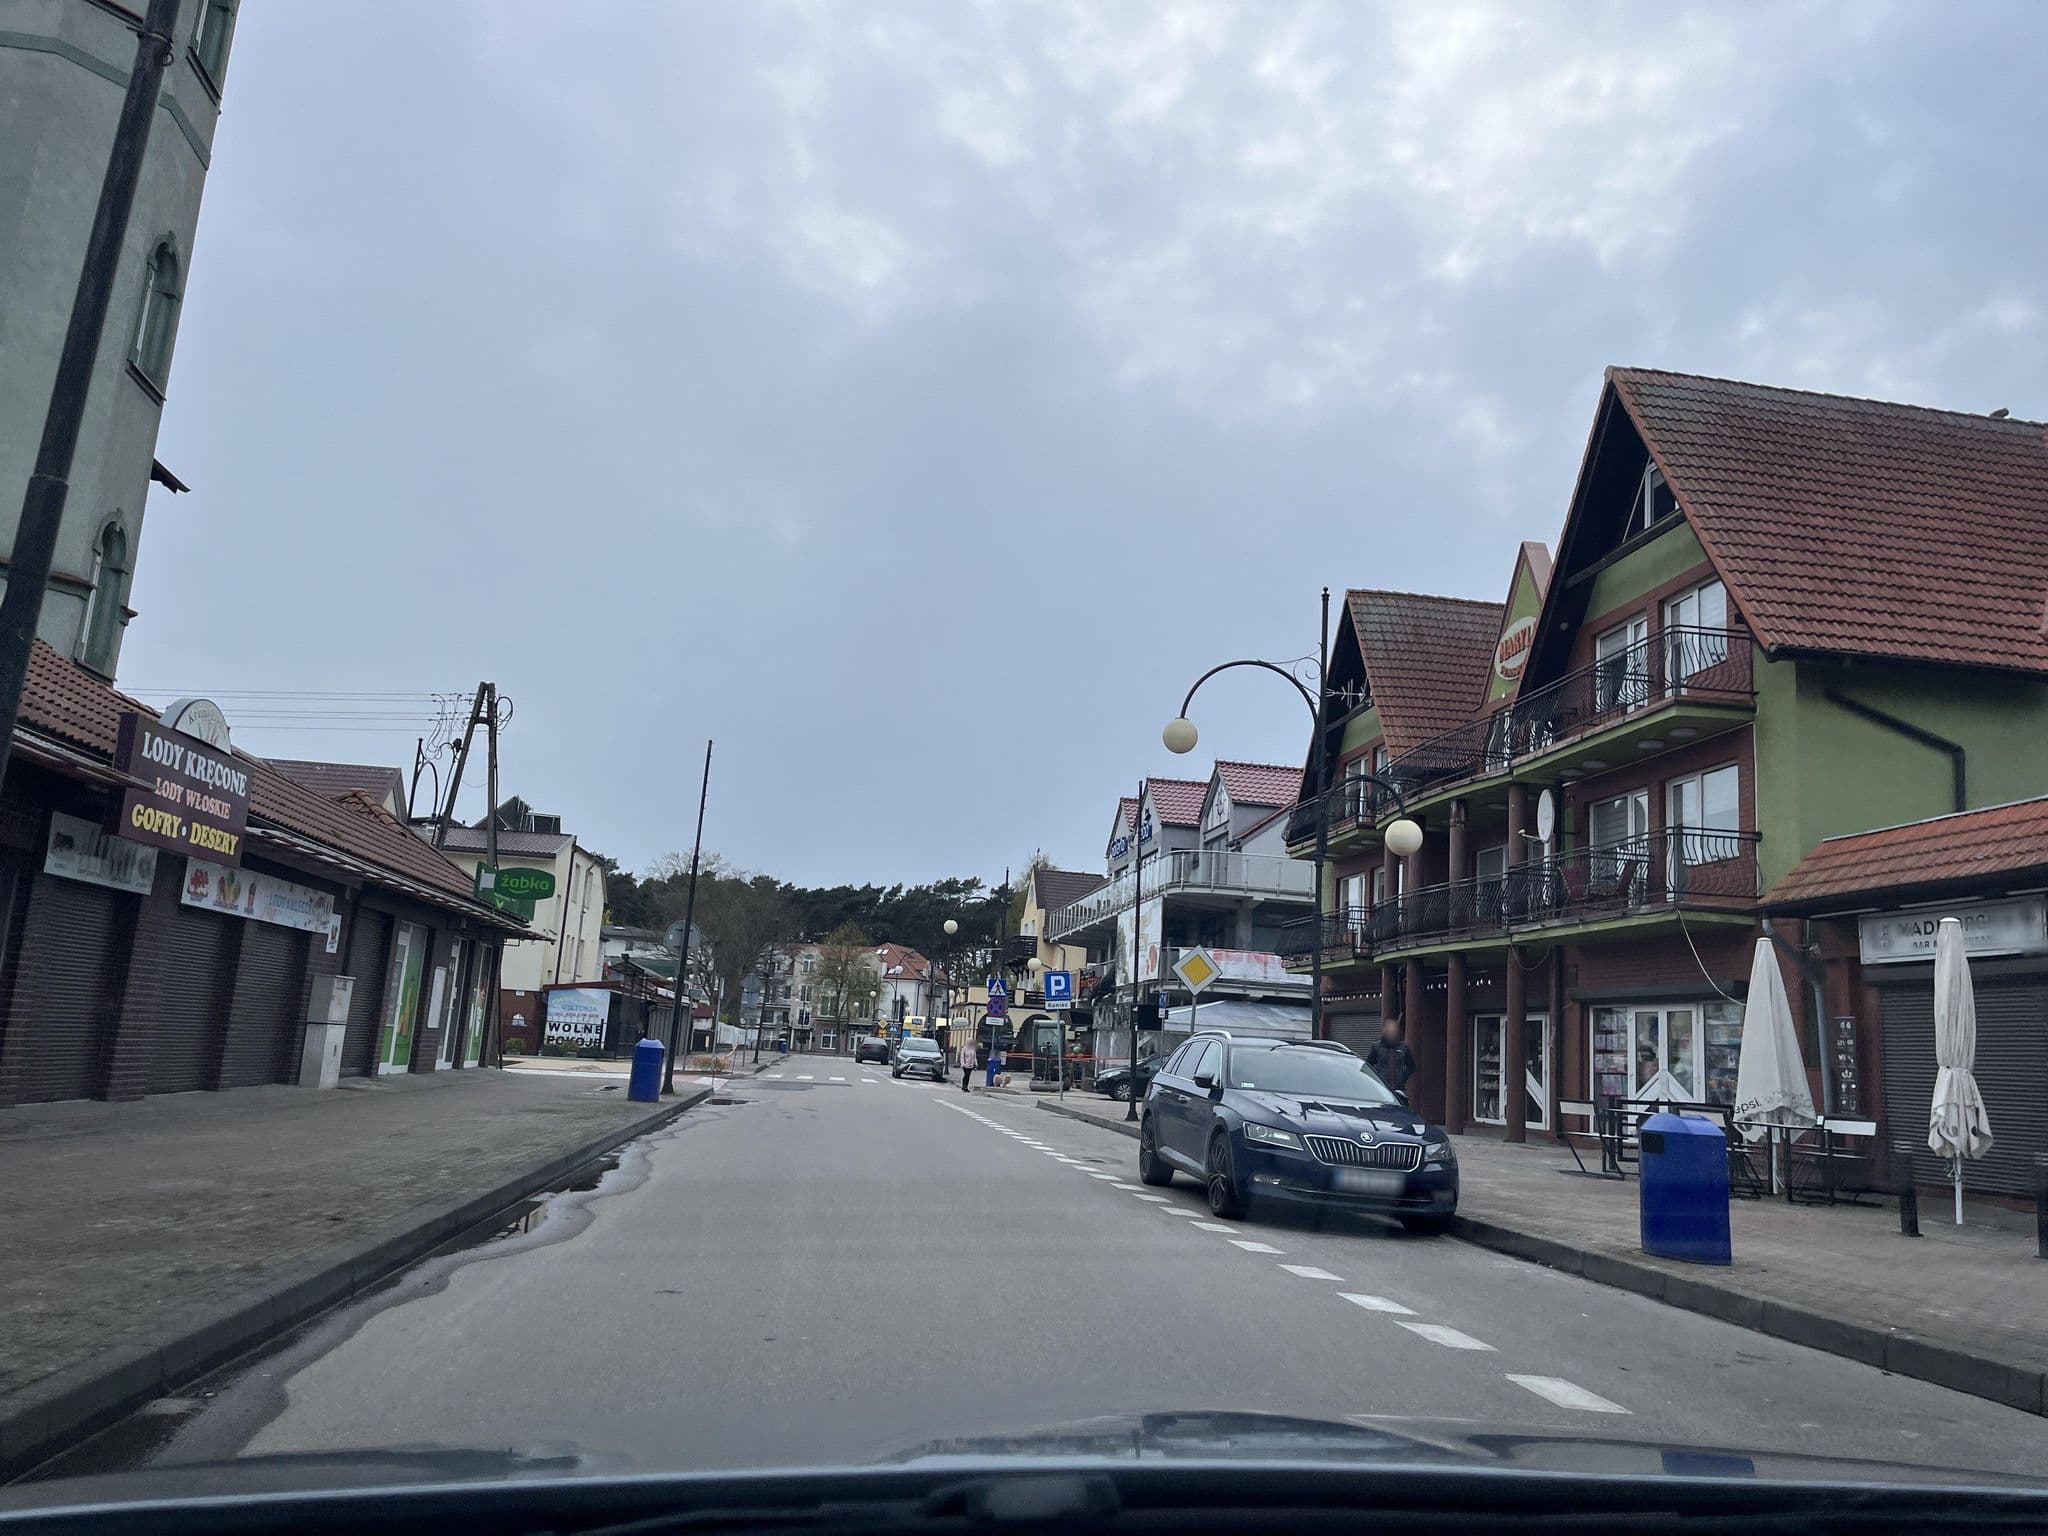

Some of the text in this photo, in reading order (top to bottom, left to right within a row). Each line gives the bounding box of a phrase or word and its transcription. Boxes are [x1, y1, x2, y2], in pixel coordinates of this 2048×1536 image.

[141, 731, 247, 798] LODY KRĘCONE
[154, 777, 231, 820] LODY WŁOSKIE
[131, 803, 239, 856] GOFRY DESERY
[501, 874, 549, 891] żabka
[1050, 975, 1065, 996] P
[548, 1022, 602, 1035] WOLNE
[1735, 1097, 1761, 1114] epsi
